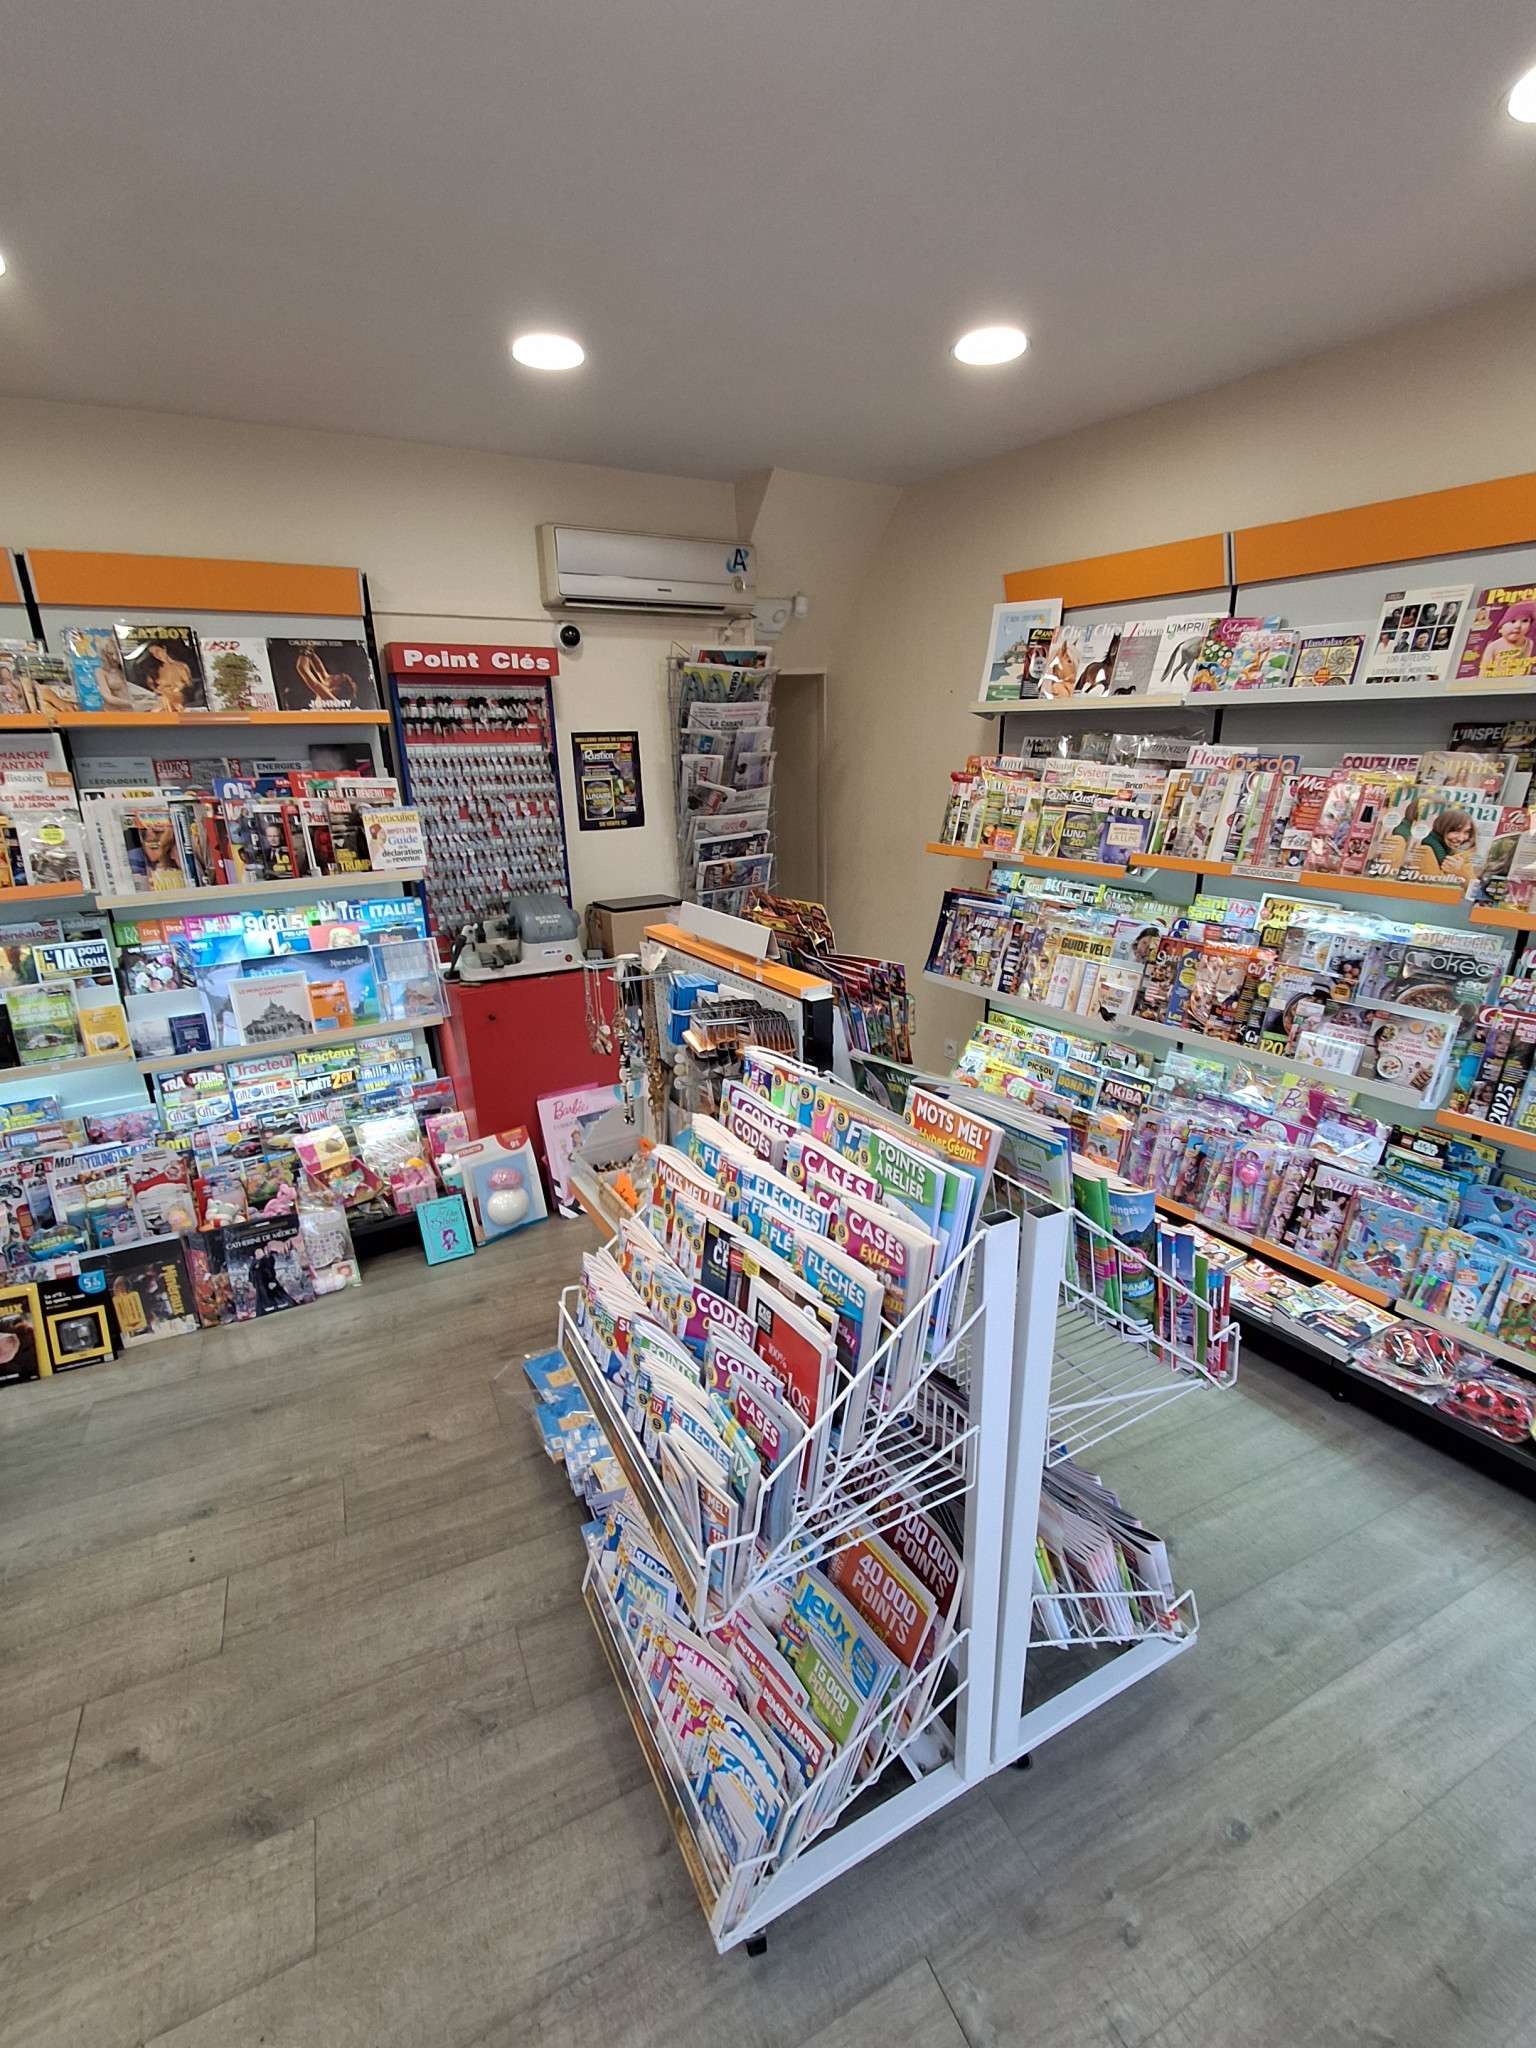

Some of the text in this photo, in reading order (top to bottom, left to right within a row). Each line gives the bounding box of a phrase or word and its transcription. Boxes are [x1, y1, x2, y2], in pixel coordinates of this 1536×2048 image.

[733, 548, 747, 572] A
[122, 626, 190, 641] LAYBOY
[403, 650, 550, 670] Point Clés
[1231, 755, 1297, 774] burda
[1343, 756, 1418, 771] COUTURE
[370, 813, 417, 823] Particulier
[388, 835, 418, 846] Guide
[382, 848, 423, 857] déclaration
[1399, 868, 1418, 880] 20
[368, 903, 416, 919] ITALIE
[78, 945, 105, 958] pour
[1061, 937, 1088, 953] GUIDE
[79, 956, 109, 967] tous
[298, 1047, 356, 1064] Tracteur
[1261, 1040, 1284, 1057] 120
[235, 1055, 293, 1075] Tracteur
[1027, 1061, 1054, 1076] PICSOU
[331, 1071, 353, 1089] 2CV
[1105, 1082, 1142, 1103] AKIBA
[553, 1101, 588, 1121] Barbie
[1489, 1082, 1515, 1126] 2025
[917, 1098, 991, 1150] MOTS MEL'
[734, 1118, 771, 1158] CODES
[948, 1138, 976, 1160] Géant
[878, 1141, 926, 1183] POINTS
[804, 1149, 868, 1200] CASES
[883, 1163, 923, 1203] RELIER
[1402, 1166, 1460, 1190] playmobil
[226, 1236, 262, 1250] CATHERINE
[849, 1212, 904, 1265] CASES
[860, 1244, 891, 1268] Extra
[697, 1294, 750, 1344] CODES
[738, 1389, 778, 1448] CASES
[900, 1503, 957, 1584] 100 000
[894, 1526, 948, 1598] POINTS
[859, 1554, 917, 1627] 40 000
[794, 1583, 851, 1649] Jeux
[852, 1574, 910, 1646] POINTS
[814, 1658, 849, 1713] 15 000
[808, 1671, 844, 1728] POINTS
